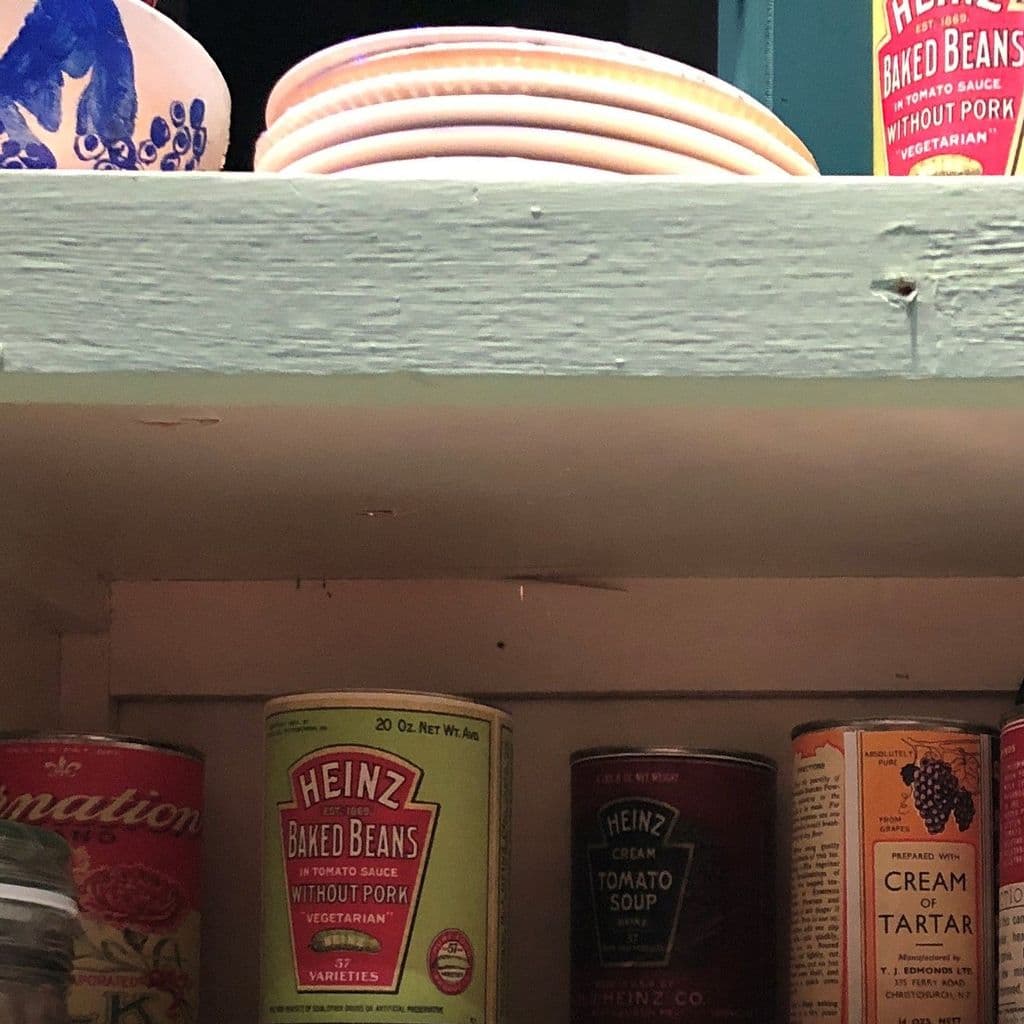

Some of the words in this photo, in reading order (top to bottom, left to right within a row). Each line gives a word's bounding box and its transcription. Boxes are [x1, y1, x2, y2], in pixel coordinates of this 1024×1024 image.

[883, 38, 937, 98] BAKED
[944, 28, 1024, 79] BEANS
[905, 82, 954, 105] TOMATO
[958, 78, 1002, 92] SAUCE
[887, 102, 954, 145] WITHOUT
[960, 98, 1014, 121] PORK
[376, 718, 391, 732] 20
[300, 761, 405, 809] HEINZ
[607, 810, 665, 837] HEINZ
[879, 816, 902, 824] FROM
[288, 820, 343, 858] BAKED
[350, 818, 418, 858] BEANS
[612, 849, 656, 860] CREAM
[314, 866, 356, 876] TOMATO
[360, 866, 398, 878] SAUCE
[598, 870, 673, 890] TOMATO
[884, 871, 966, 892] CREAM
[291, 884, 358, 904] WITHOUT
[364, 884, 408, 904] PORK
[610, 894, 658, 911] SOUP
[920, 898, 936, 908] OF
[878, 914, 974, 934] TARTAR
[334, 958, 351, 968] 57
[309, 970, 379, 982] VARIETIES
